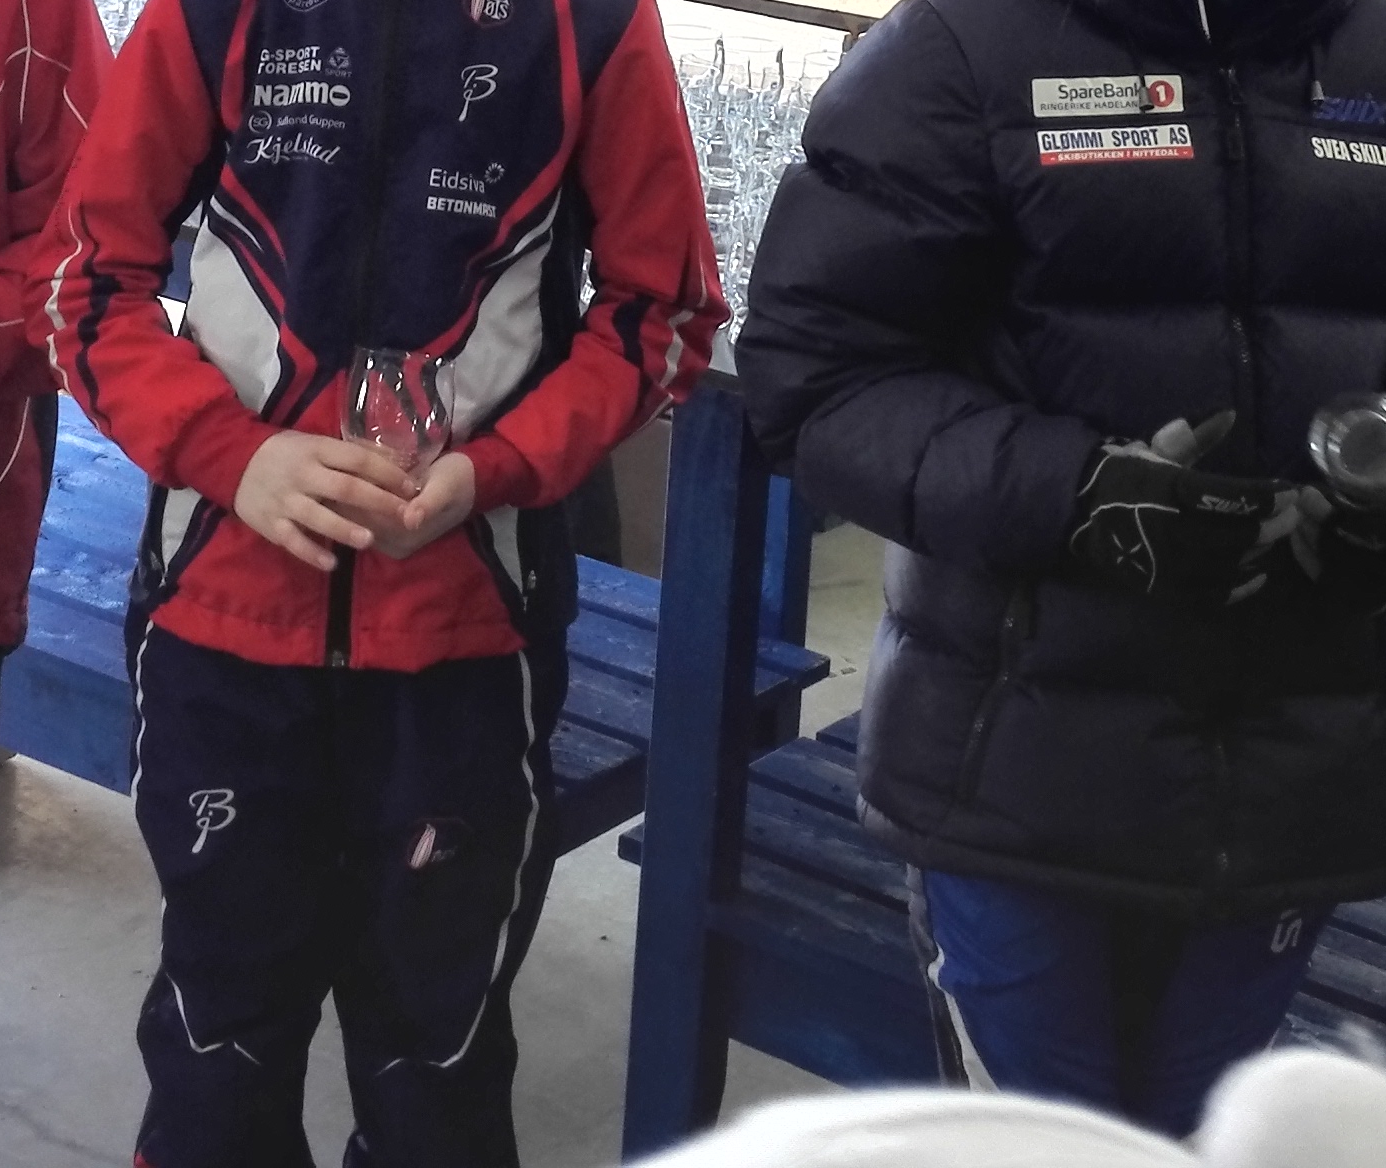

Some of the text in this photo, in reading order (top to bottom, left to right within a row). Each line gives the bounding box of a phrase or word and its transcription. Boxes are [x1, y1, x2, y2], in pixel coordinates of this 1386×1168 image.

[1094, 100, 1139, 110] HADELAN
[1042, 127, 1188, 151] GLØMMI SPORT AS
[1311, 136, 1351, 161] SVEA
[429, 168, 485, 193] Eidsiva
